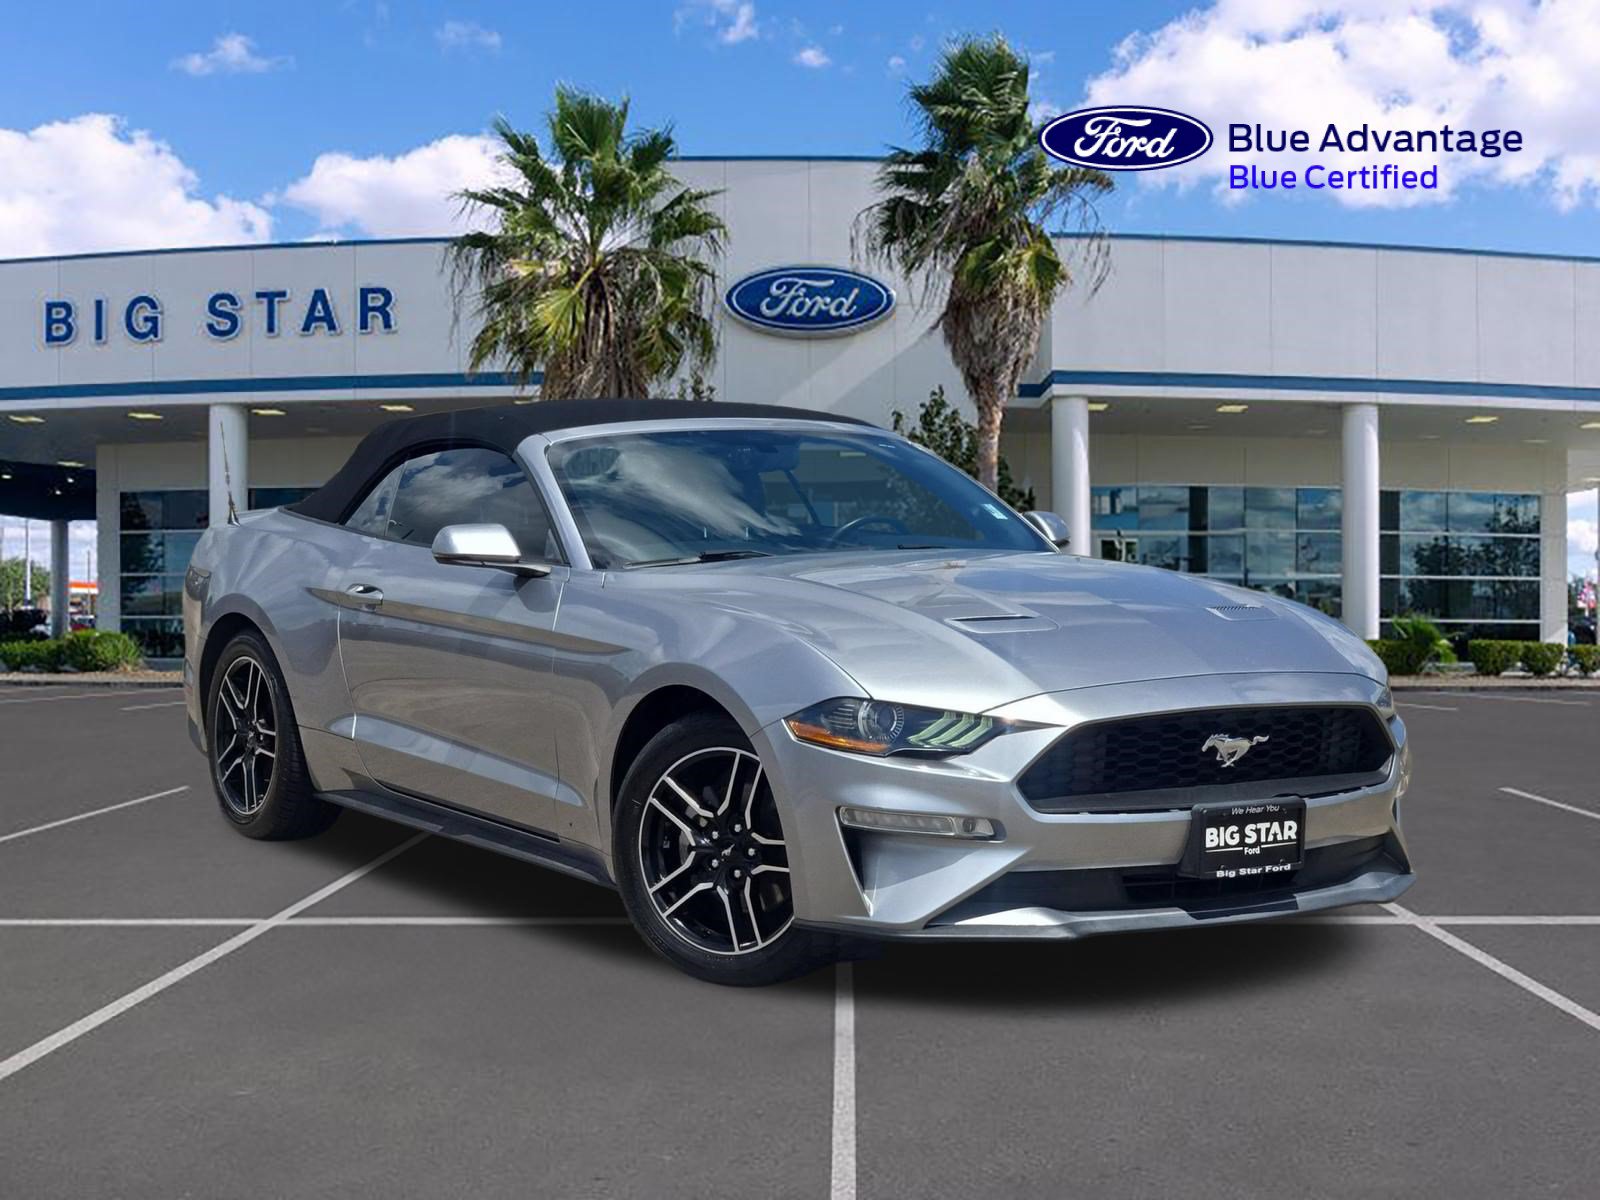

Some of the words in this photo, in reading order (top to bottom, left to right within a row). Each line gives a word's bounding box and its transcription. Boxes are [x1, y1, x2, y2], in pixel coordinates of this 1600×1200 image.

[760, 277, 859, 317] Ford
[44, 295, 162, 344] BIG
[206, 287, 396, 338] STAR
[1231, 807, 1244, 815] We
[1246, 806, 1264, 814] Hear
[1205, 825, 1240, 848] BIG
[1244, 820, 1298, 844] STAR
[1244, 846, 1261, 855] Ford
[1216, 870, 1236, 878] Big
[1239, 867, 1262, 875] Star
[1265, 864, 1291, 872] Ford
